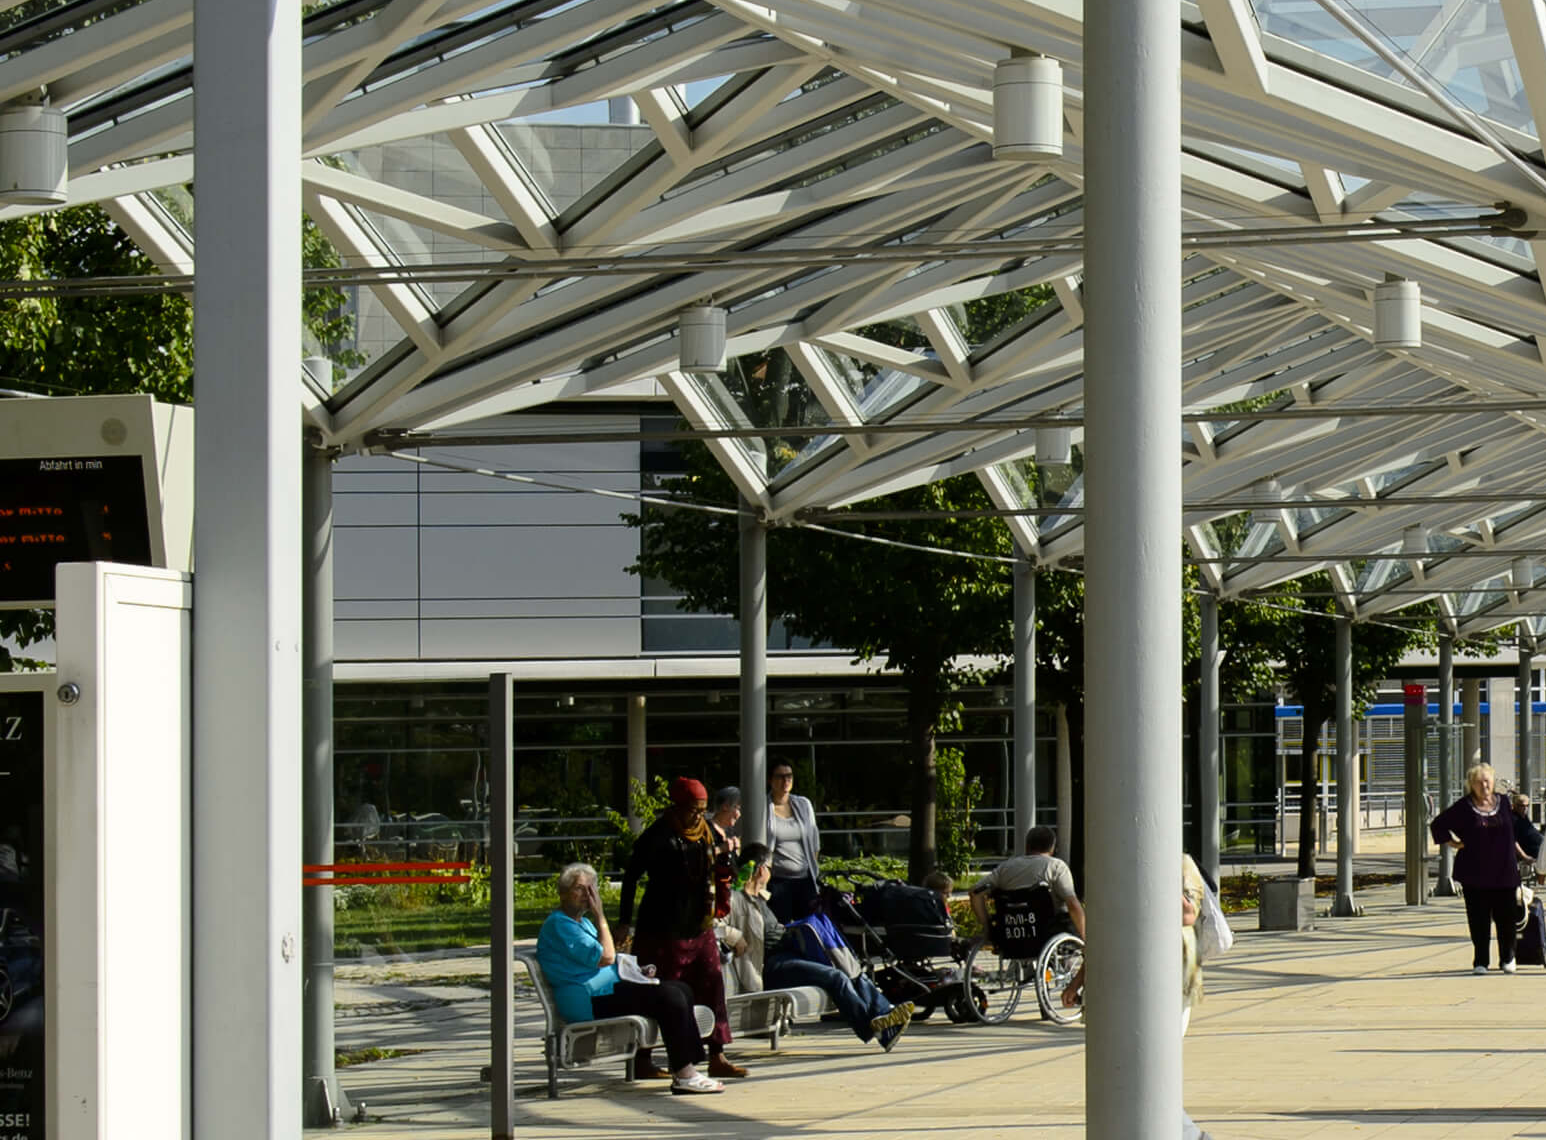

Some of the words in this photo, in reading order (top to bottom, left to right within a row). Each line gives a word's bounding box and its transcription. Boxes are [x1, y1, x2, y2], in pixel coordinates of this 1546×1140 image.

[39, 460, 73, 471] Abfahrt
[75, 460, 83, 470] in
[86, 460, 103, 470] min
